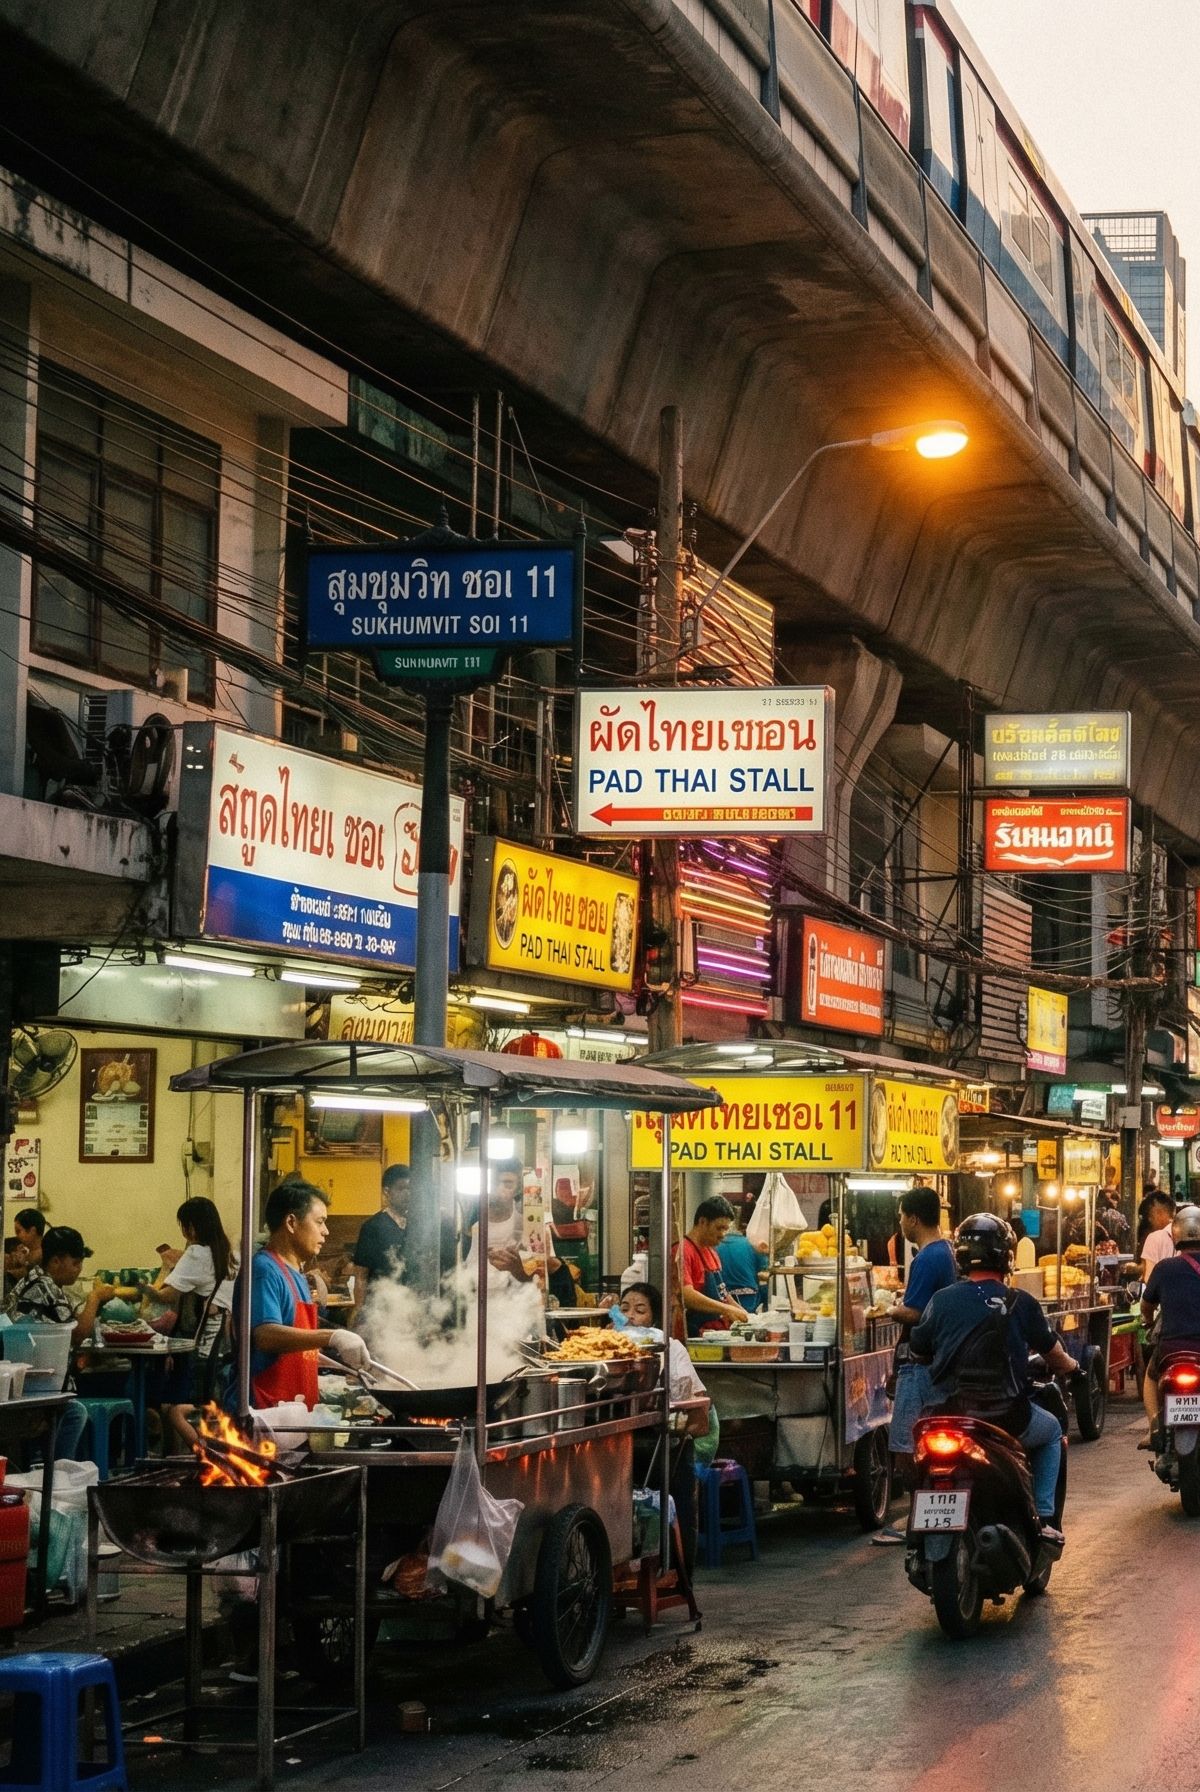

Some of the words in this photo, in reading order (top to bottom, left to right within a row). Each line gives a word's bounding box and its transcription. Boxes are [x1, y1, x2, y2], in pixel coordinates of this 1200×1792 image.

[527, 565, 555, 598] 11
[351, 615, 461, 636] SUKHUMVIT
[469, 615, 500, 635] SOI
[509, 614, 528, 634] 11
[589, 768, 643, 794] PAD
[654, 767, 717, 793] THAI
[729, 767, 815, 793] STALL
[520, 933, 543, 960] PAD
[546, 938, 571, 966] THAI
[574, 943, 606, 972] STALL
[829, 1099, 856, 1130] 11
[670, 1142, 708, 1161] PAD
[714, 1142, 762, 1161] THAI
[769, 1141, 834, 1161] STALL
